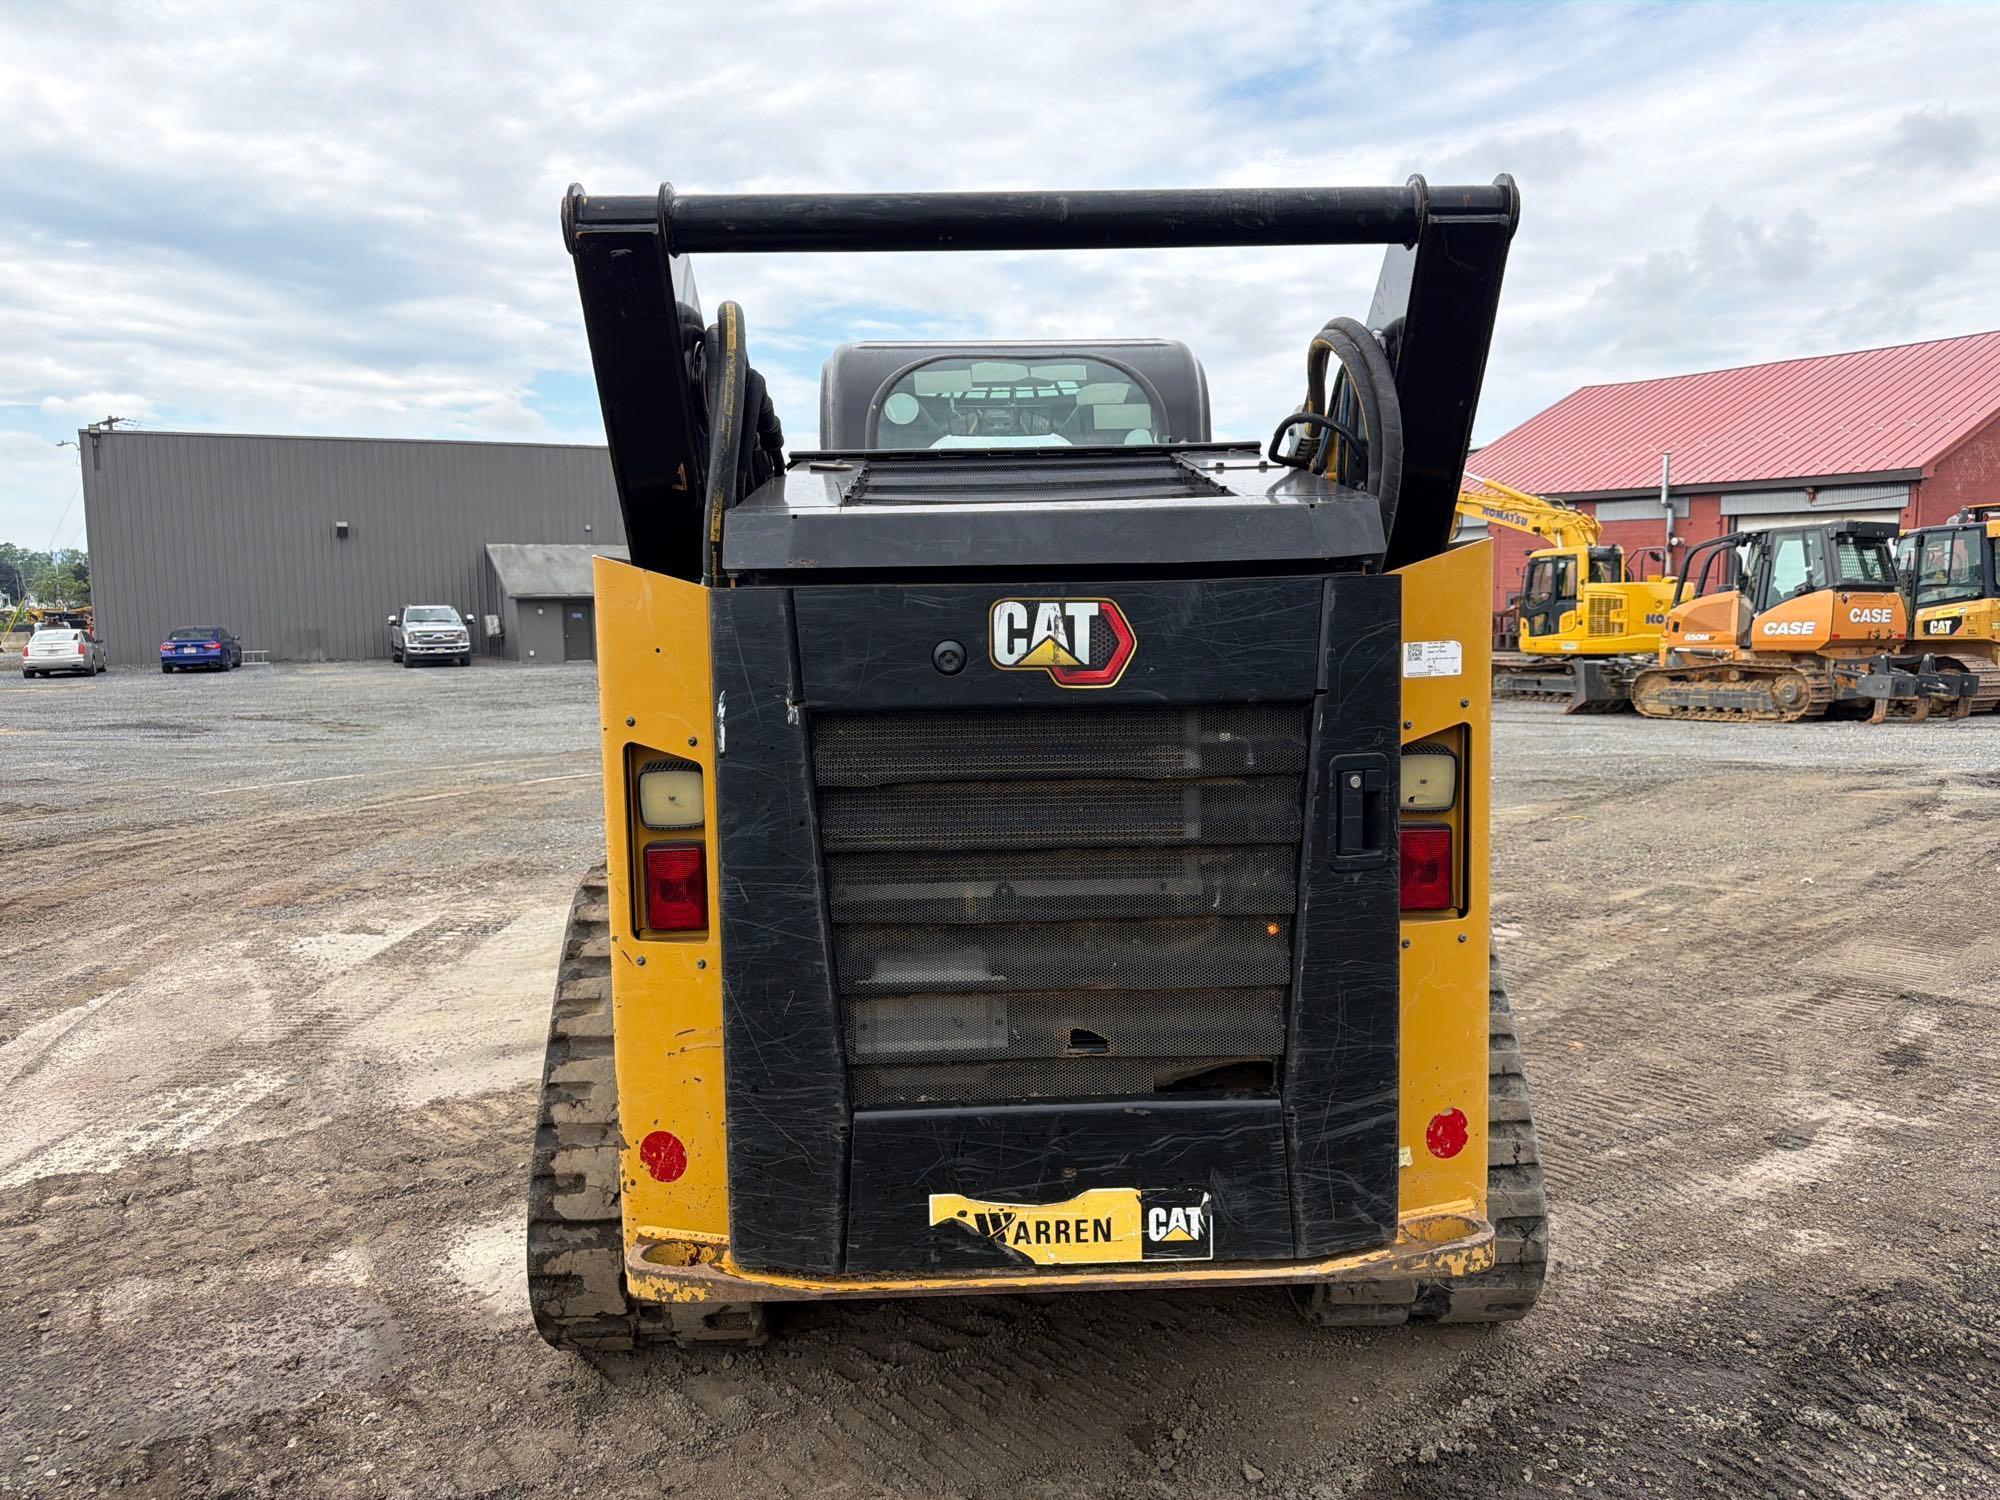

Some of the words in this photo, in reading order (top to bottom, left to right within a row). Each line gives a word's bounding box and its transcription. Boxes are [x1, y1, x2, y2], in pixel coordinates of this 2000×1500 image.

[1482, 506, 1528, 526] KOMATSU
[1850, 607, 1892, 624] CASE
[994, 601, 1098, 665] CAT
[1763, 621, 1816, 636] CASE
[1930, 620, 1952, 634] CAT
[974, 1212, 1112, 1245] WARREN
[1149, 1207, 1201, 1241] CAT
